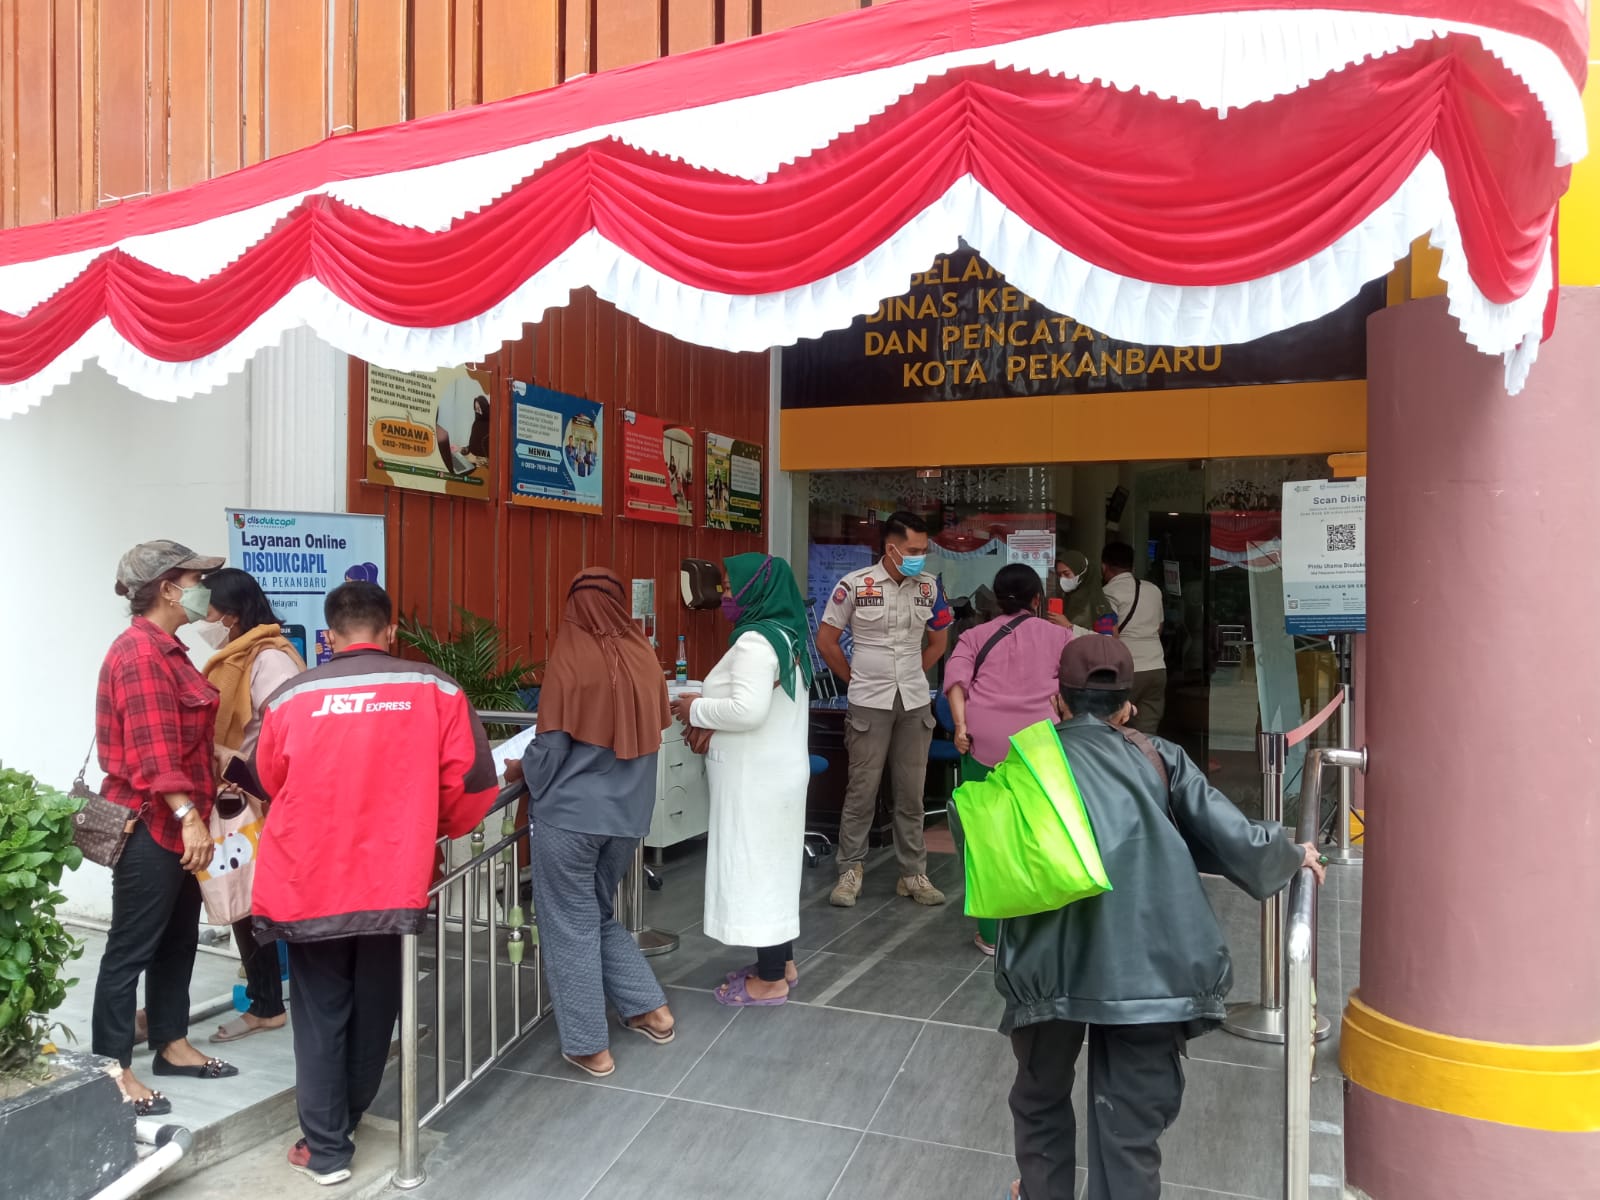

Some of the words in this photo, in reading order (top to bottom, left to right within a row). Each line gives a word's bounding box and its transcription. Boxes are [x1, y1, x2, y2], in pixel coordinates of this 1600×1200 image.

[865, 328, 927, 358] DAN
[942, 317, 1108, 351] PENCATA
[902, 359, 988, 389] KOTA
[1006, 345, 1224, 383] PEKANBARU
[381, 422, 429, 442] PANDAWA
[1313, 496, 1337, 505] Scan
[247, 516, 296, 527] disdukcapil
[242, 531, 301, 550] Layanan
[305, 534, 347, 550] Online
[243, 551, 328, 574] DISDUKCAPIL
[272, 576, 327, 588] PEKANBARU
[311, 692, 377, 717] J&T
[365, 701, 412, 713] EXPRESS
